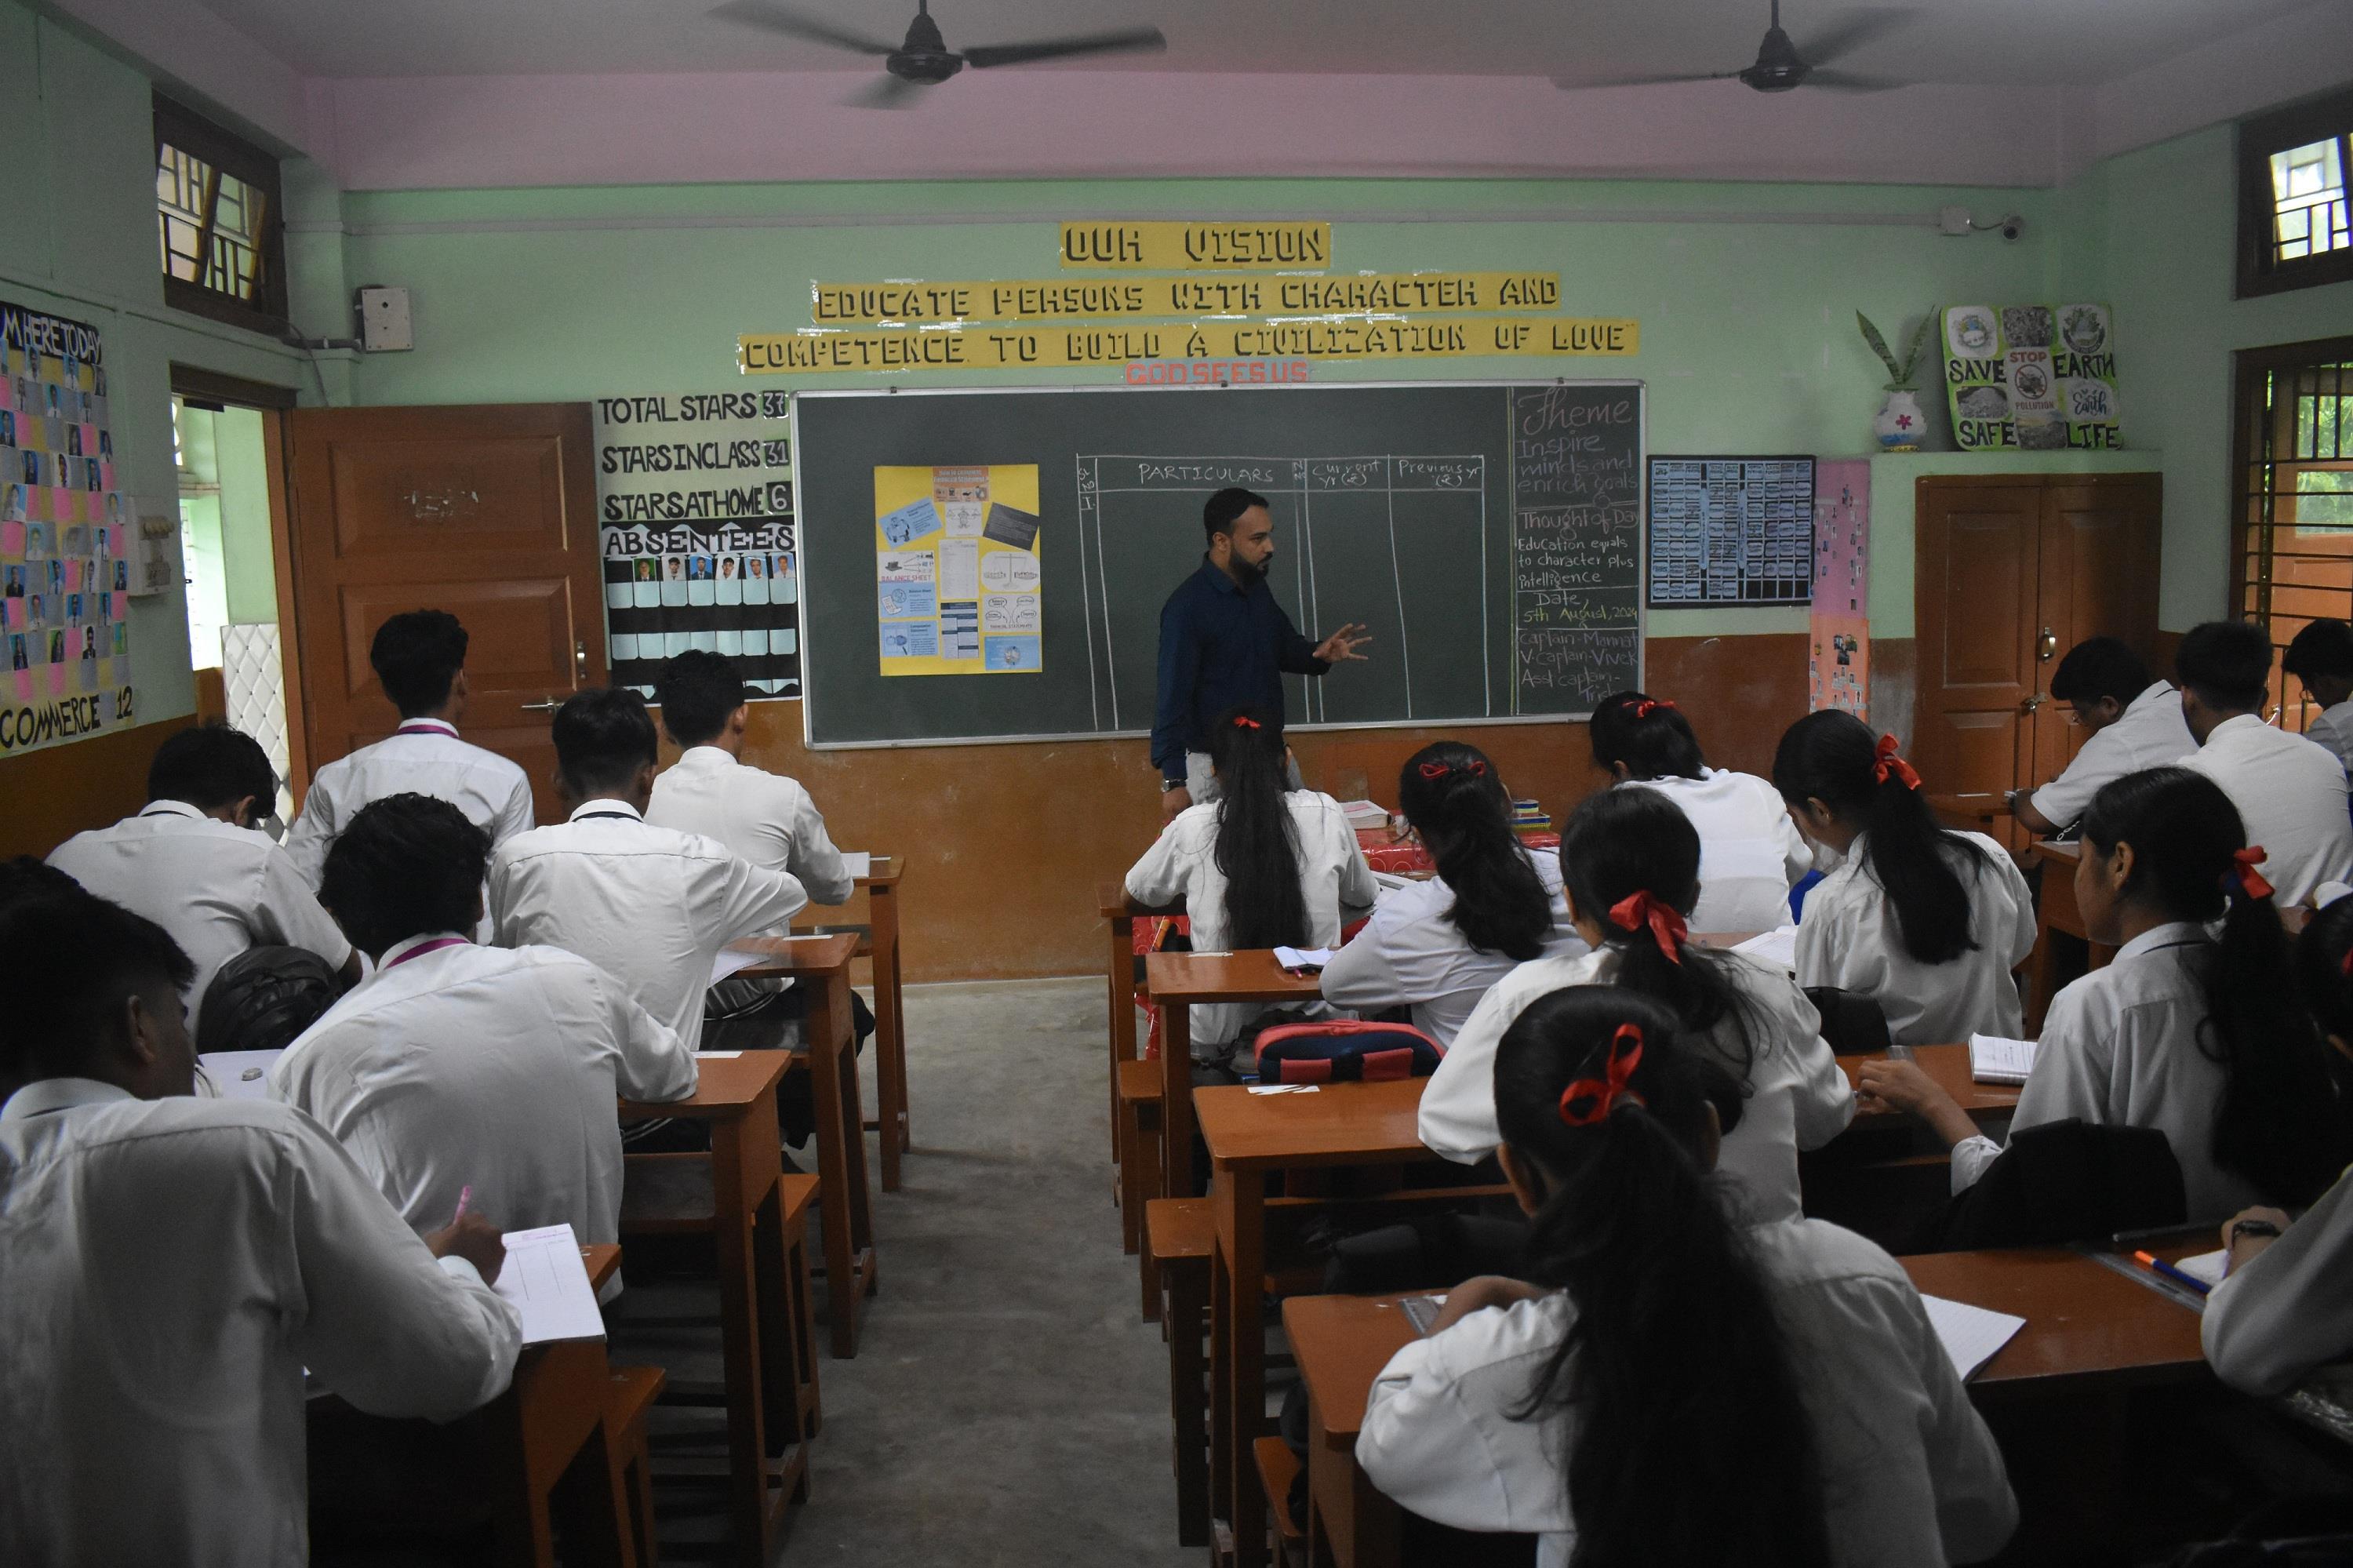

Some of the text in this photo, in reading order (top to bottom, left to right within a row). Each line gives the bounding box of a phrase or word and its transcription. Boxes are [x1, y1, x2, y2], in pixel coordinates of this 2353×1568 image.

[1184, 227, 1325, 263] VISION
[817, 278, 1558, 318] EDUCATE PERSONS WITH CHARACTER AND
[744, 334, 966, 369] COMPETENCE
[989, 335, 1038, 362] TO
[1067, 331, 1161, 362] BUILD
[1186, 329, 1209, 358] A
[1234, 324, 1467, 356] CIVILIZATION
[1494, 324, 1530, 351] OF
[2009, 351, 2048, 364] STOP
[1125, 361, 1308, 384] GOD SEES US
[1948, 351, 2116, 384] SAVE EARTH
[598, 391, 785, 424] TOTAL STARS 37
[1517, 386, 1633, 436] Theme
[2015, 400, 2055, 410] POLLUTION
[2072, 390, 2108, 417] Earth
[1516, 429, 1606, 463] Inspire
[1958, 420, 2121, 449] SAFE LIFE
[602, 439, 790, 475] STARS IN CLASS 31
[1398, 460, 1463, 478] Previous
[1520, 453, 1588, 478] minds
[1591, 448, 1632, 473] and
[1138, 463, 1274, 484] PARTICULARS
[603, 483, 788, 522] STARS AT HOME 6
[1517, 472, 1587, 493] enrich
[1589, 471, 1638, 509] goals
[1518, 507, 1588, 541] Thought
[1590, 508, 1611, 535] of
[1613, 509, 1639, 532] Day
[605, 526, 795, 556] ABSENTEES
[1590, 535, 1628, 553] equals
[1518, 552, 1635, 569] to character plus
[1518, 569, 1602, 589] intelligence
[1524, 607, 1549, 623] 5th
[0, 685, 133, 749] COMMERCE 12
